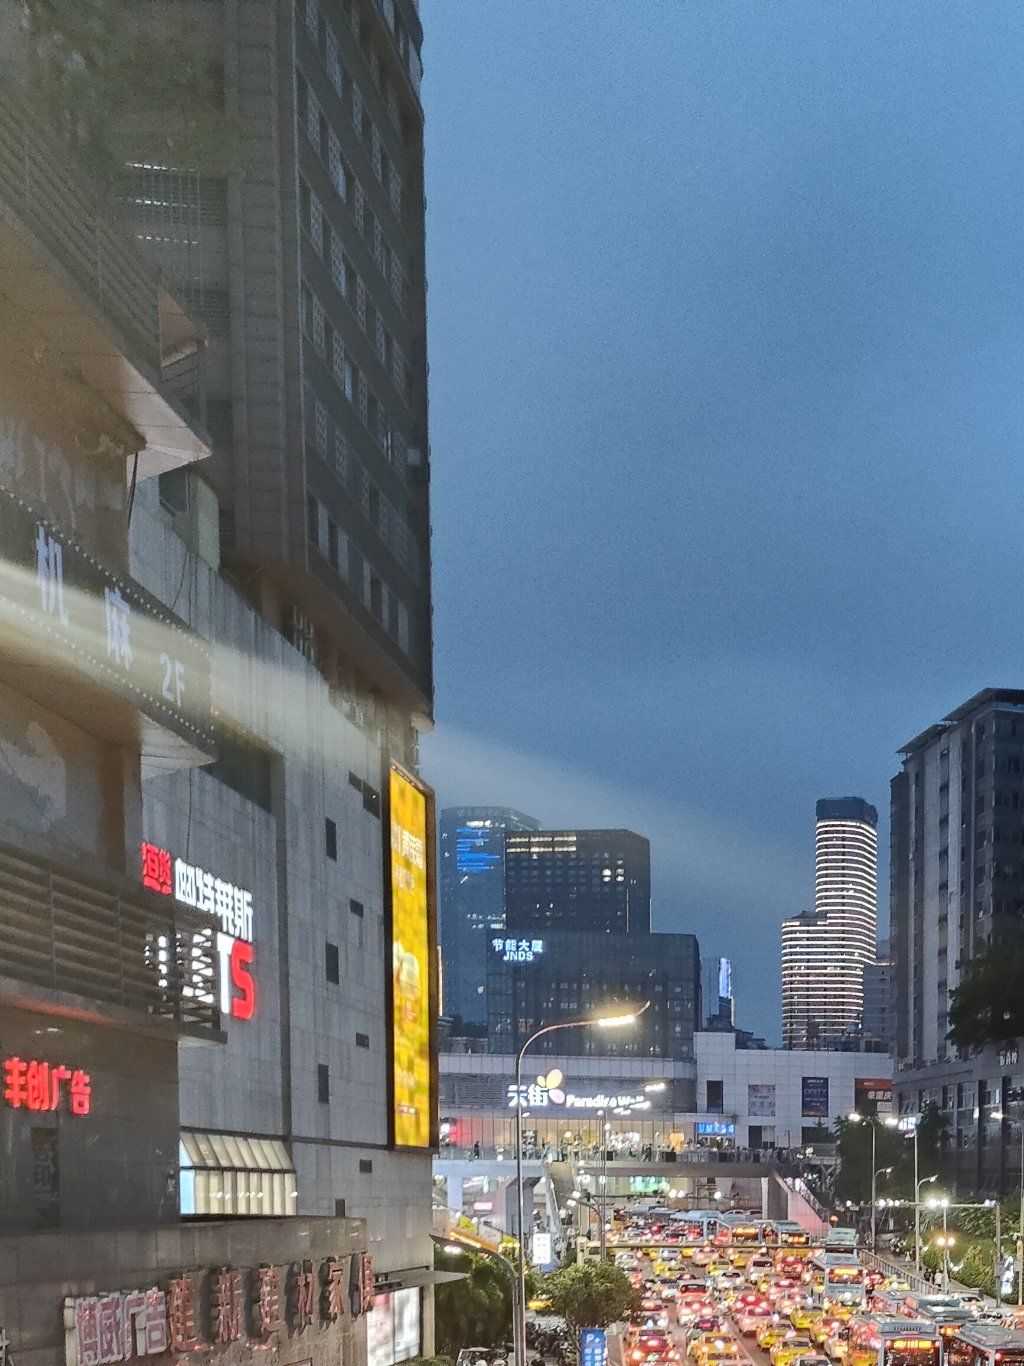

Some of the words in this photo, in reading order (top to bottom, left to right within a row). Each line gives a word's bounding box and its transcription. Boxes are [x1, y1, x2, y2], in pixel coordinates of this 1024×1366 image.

[492, 938, 543, 953] 节能大厦
[503, 951, 533, 961] JNDS
[507, 1083, 549, 1107] 天街
